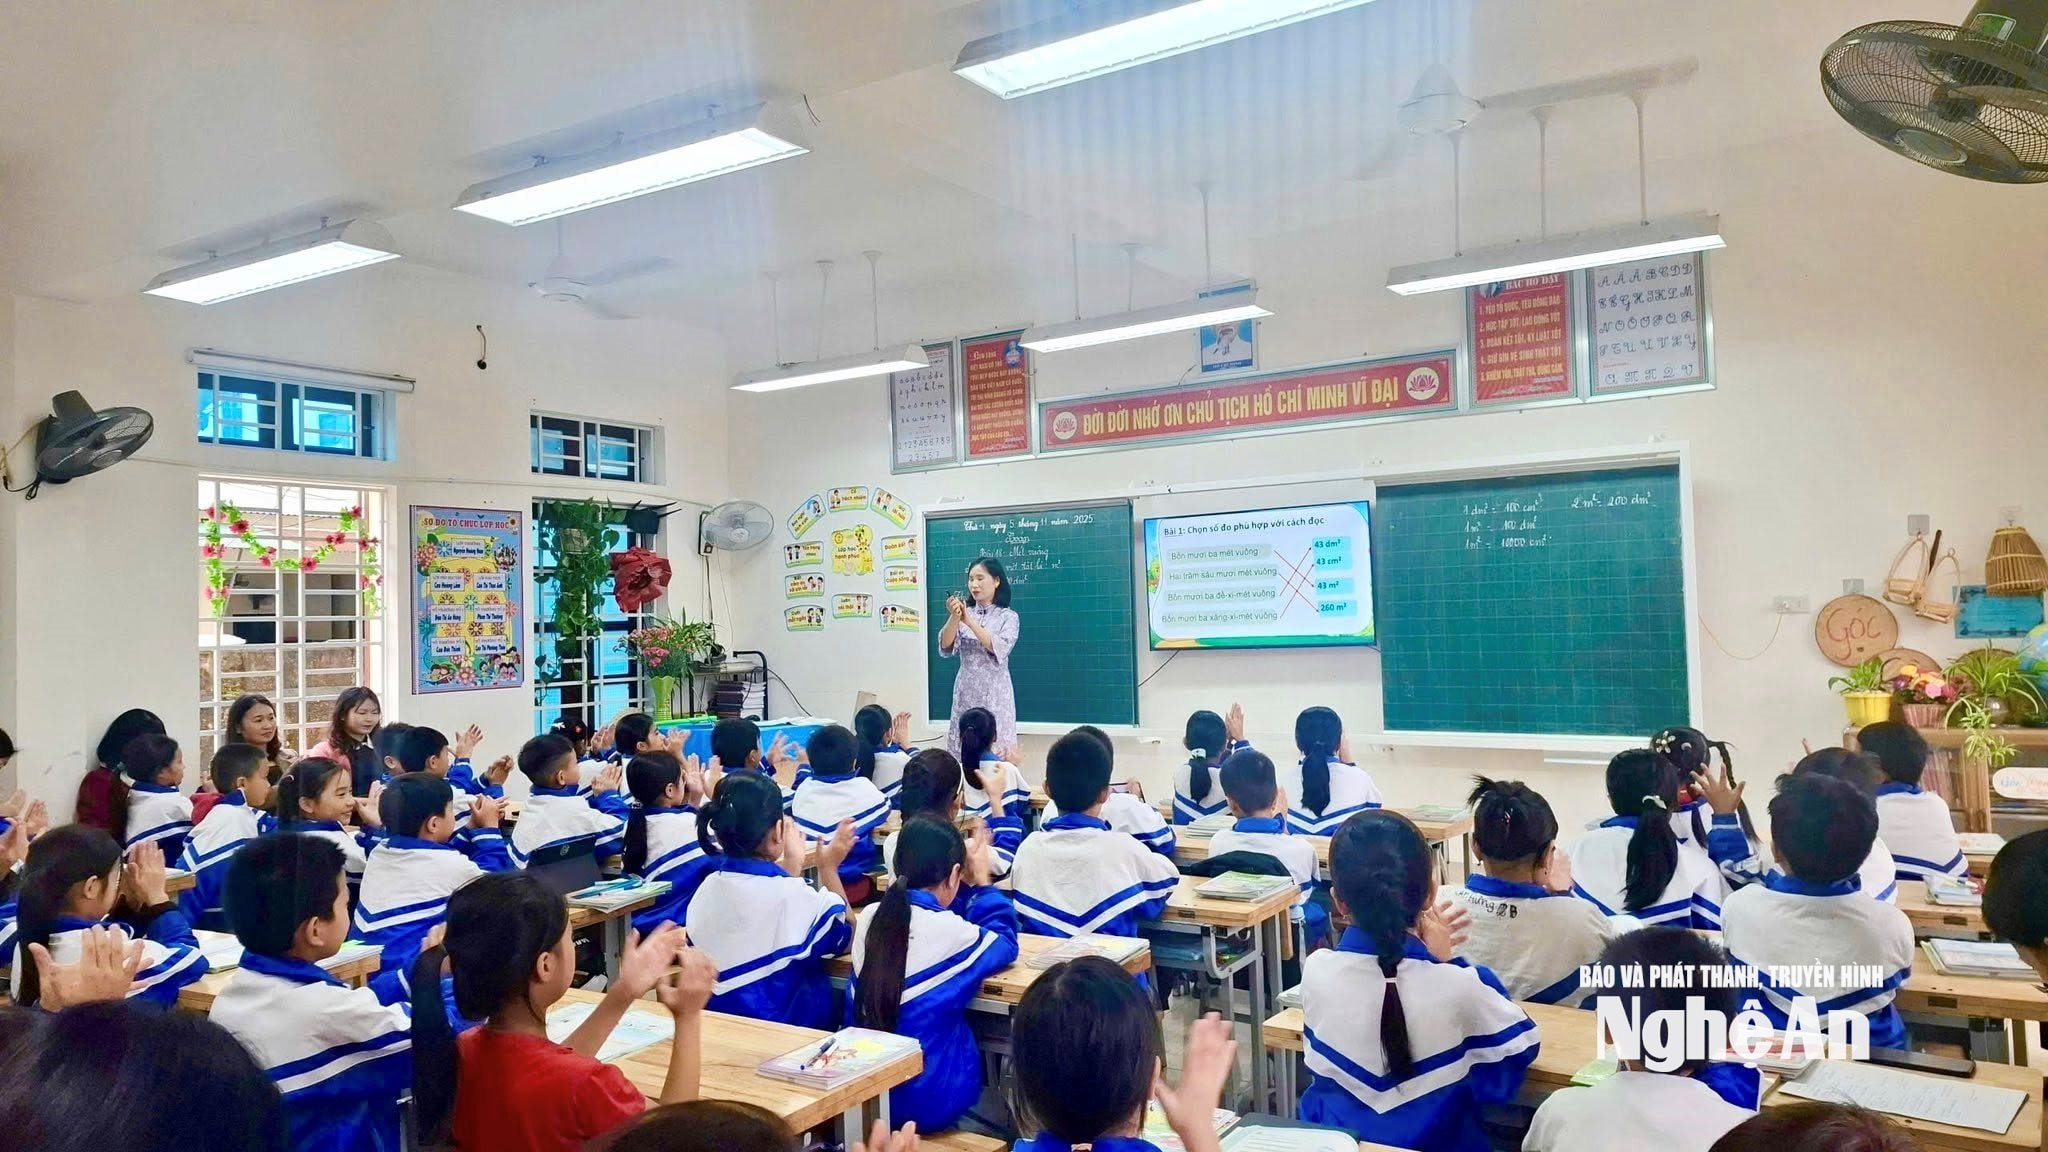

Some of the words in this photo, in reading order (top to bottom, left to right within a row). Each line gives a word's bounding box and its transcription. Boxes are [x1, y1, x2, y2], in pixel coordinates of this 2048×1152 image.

[1083, 408, 1104, 436] ĐỜI
[1108, 404, 1129, 432] ĐỜI
[1133, 400, 1160, 430] NHỚ
[1164, 404, 1183, 426] ƠN
[1186, 390, 1214, 424] CHỦ
[1217, 395, 1249, 425] TỊCH
[1254, 385, 1273, 417] HỒ
[1278, 384, 1302, 414] CHÍ
[1306, 384, 1348, 411] MINH
[1352, 376, 1368, 406] VĨ
[1372, 377, 1398, 407] ĐẠI
